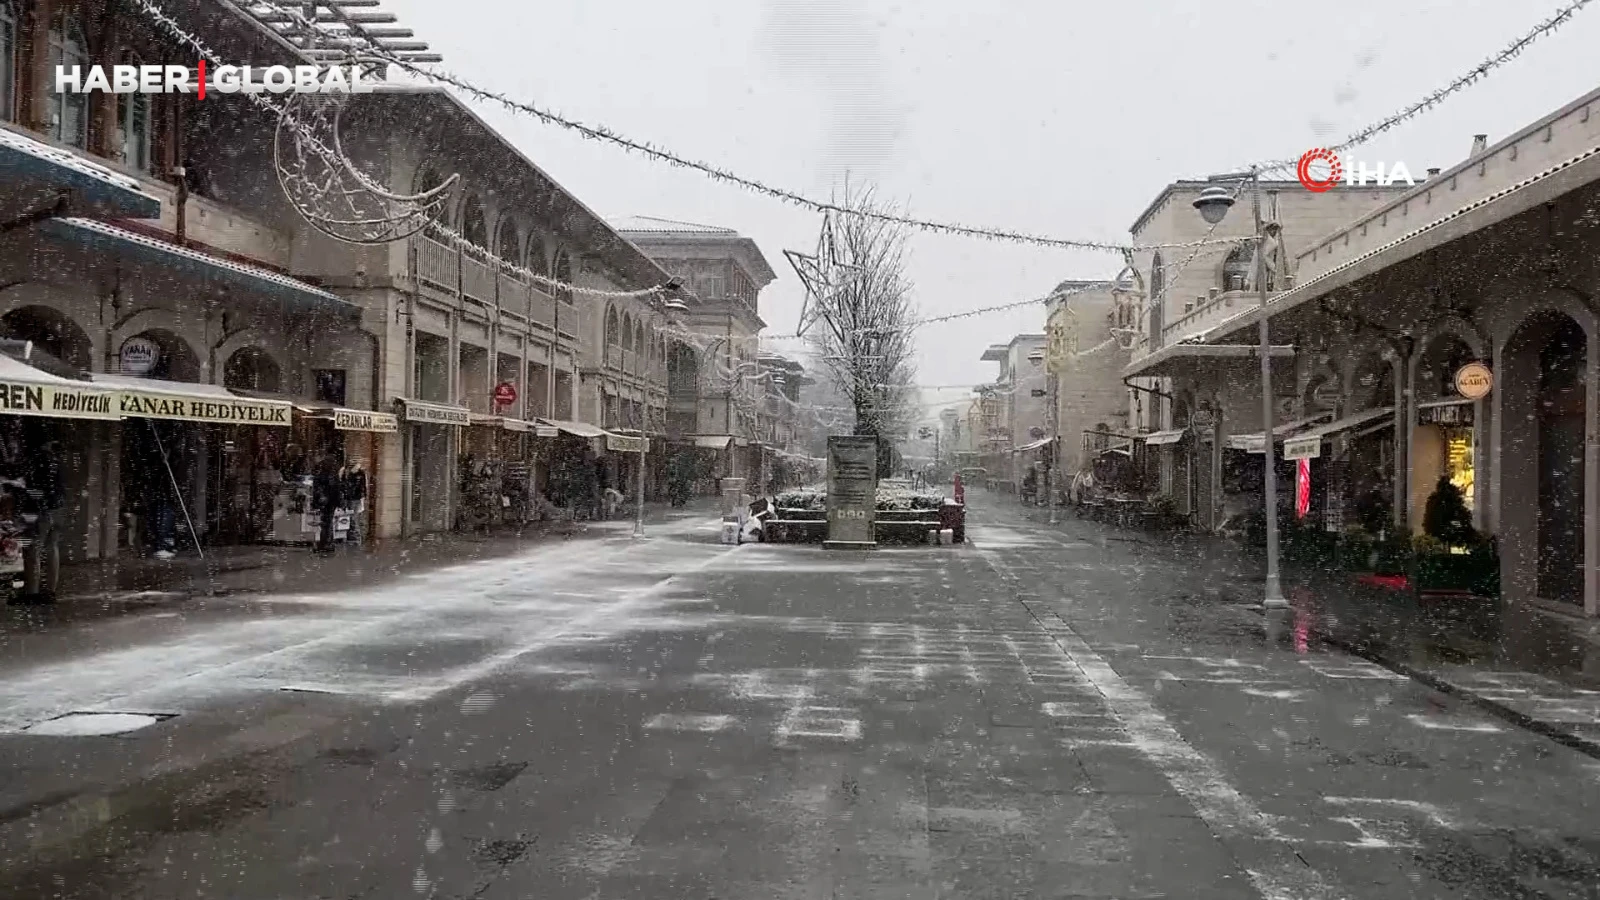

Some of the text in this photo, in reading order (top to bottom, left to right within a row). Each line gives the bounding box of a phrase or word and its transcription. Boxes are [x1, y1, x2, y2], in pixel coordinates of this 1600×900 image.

[53, 391, 111, 413] HEDİYELİK
[120, 394, 286, 422] YANAR HEDİYELİK
